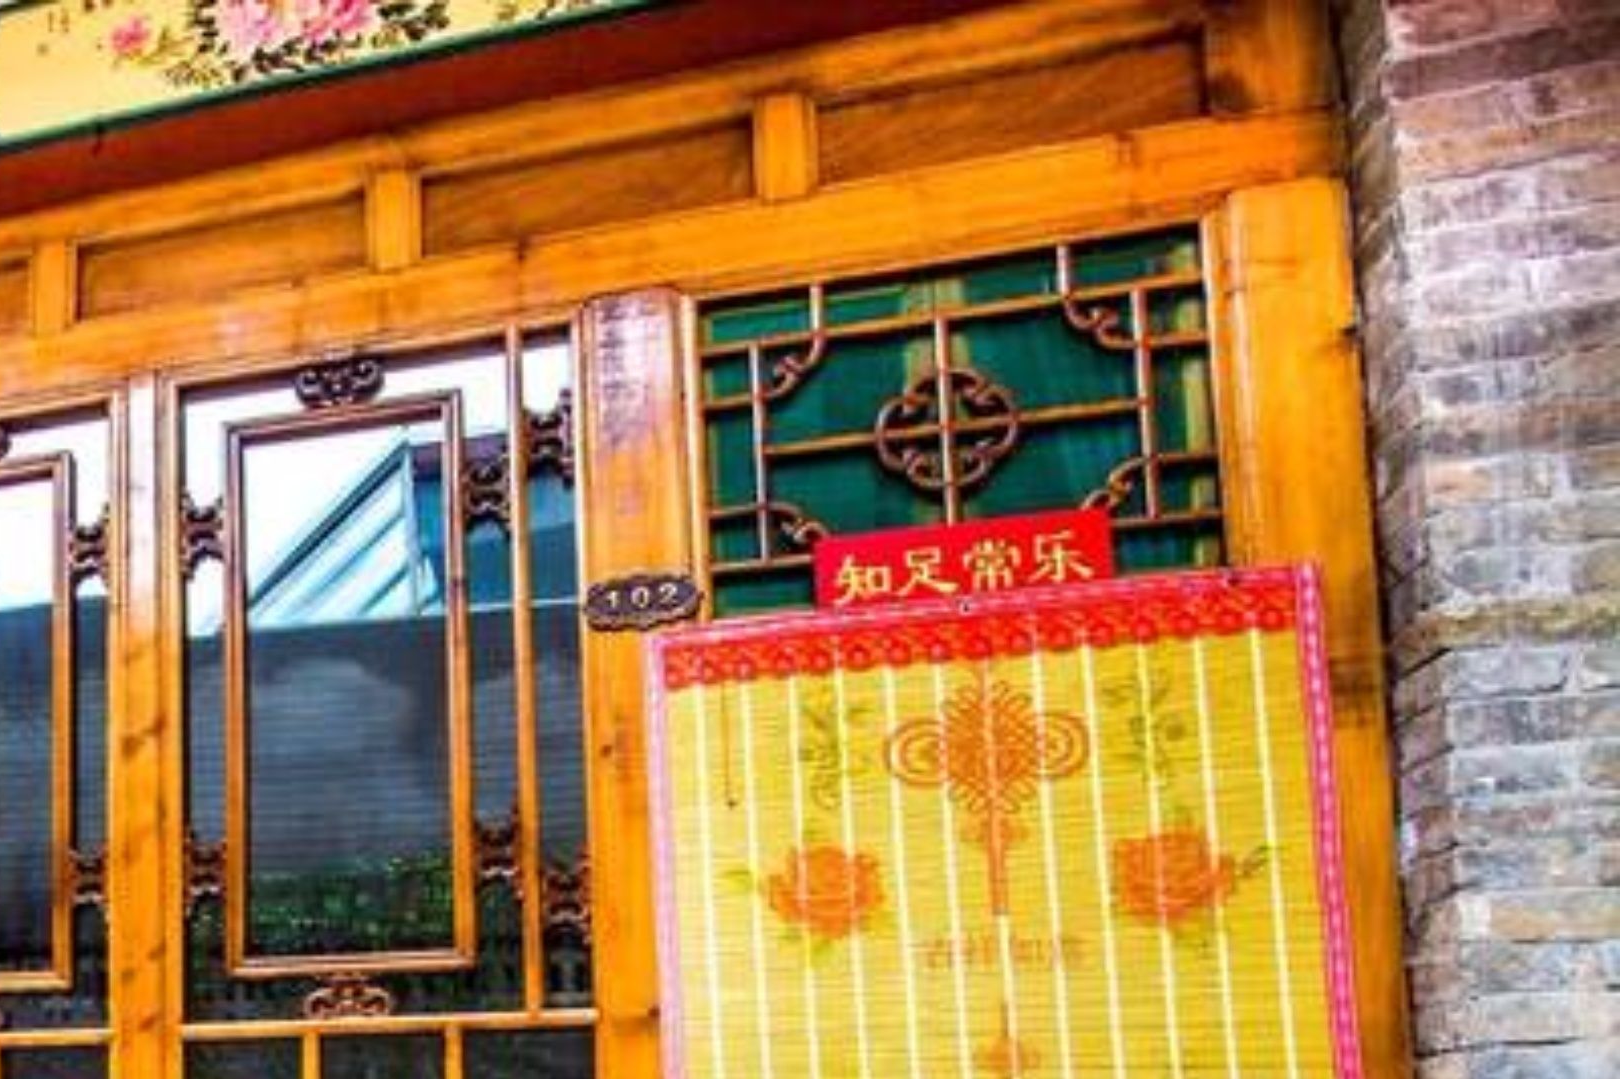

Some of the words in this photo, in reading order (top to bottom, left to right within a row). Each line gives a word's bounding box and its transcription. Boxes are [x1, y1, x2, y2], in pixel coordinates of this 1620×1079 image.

[833, 529, 1094, 606] 知足常乐
[606, 582, 679, 608] 102
